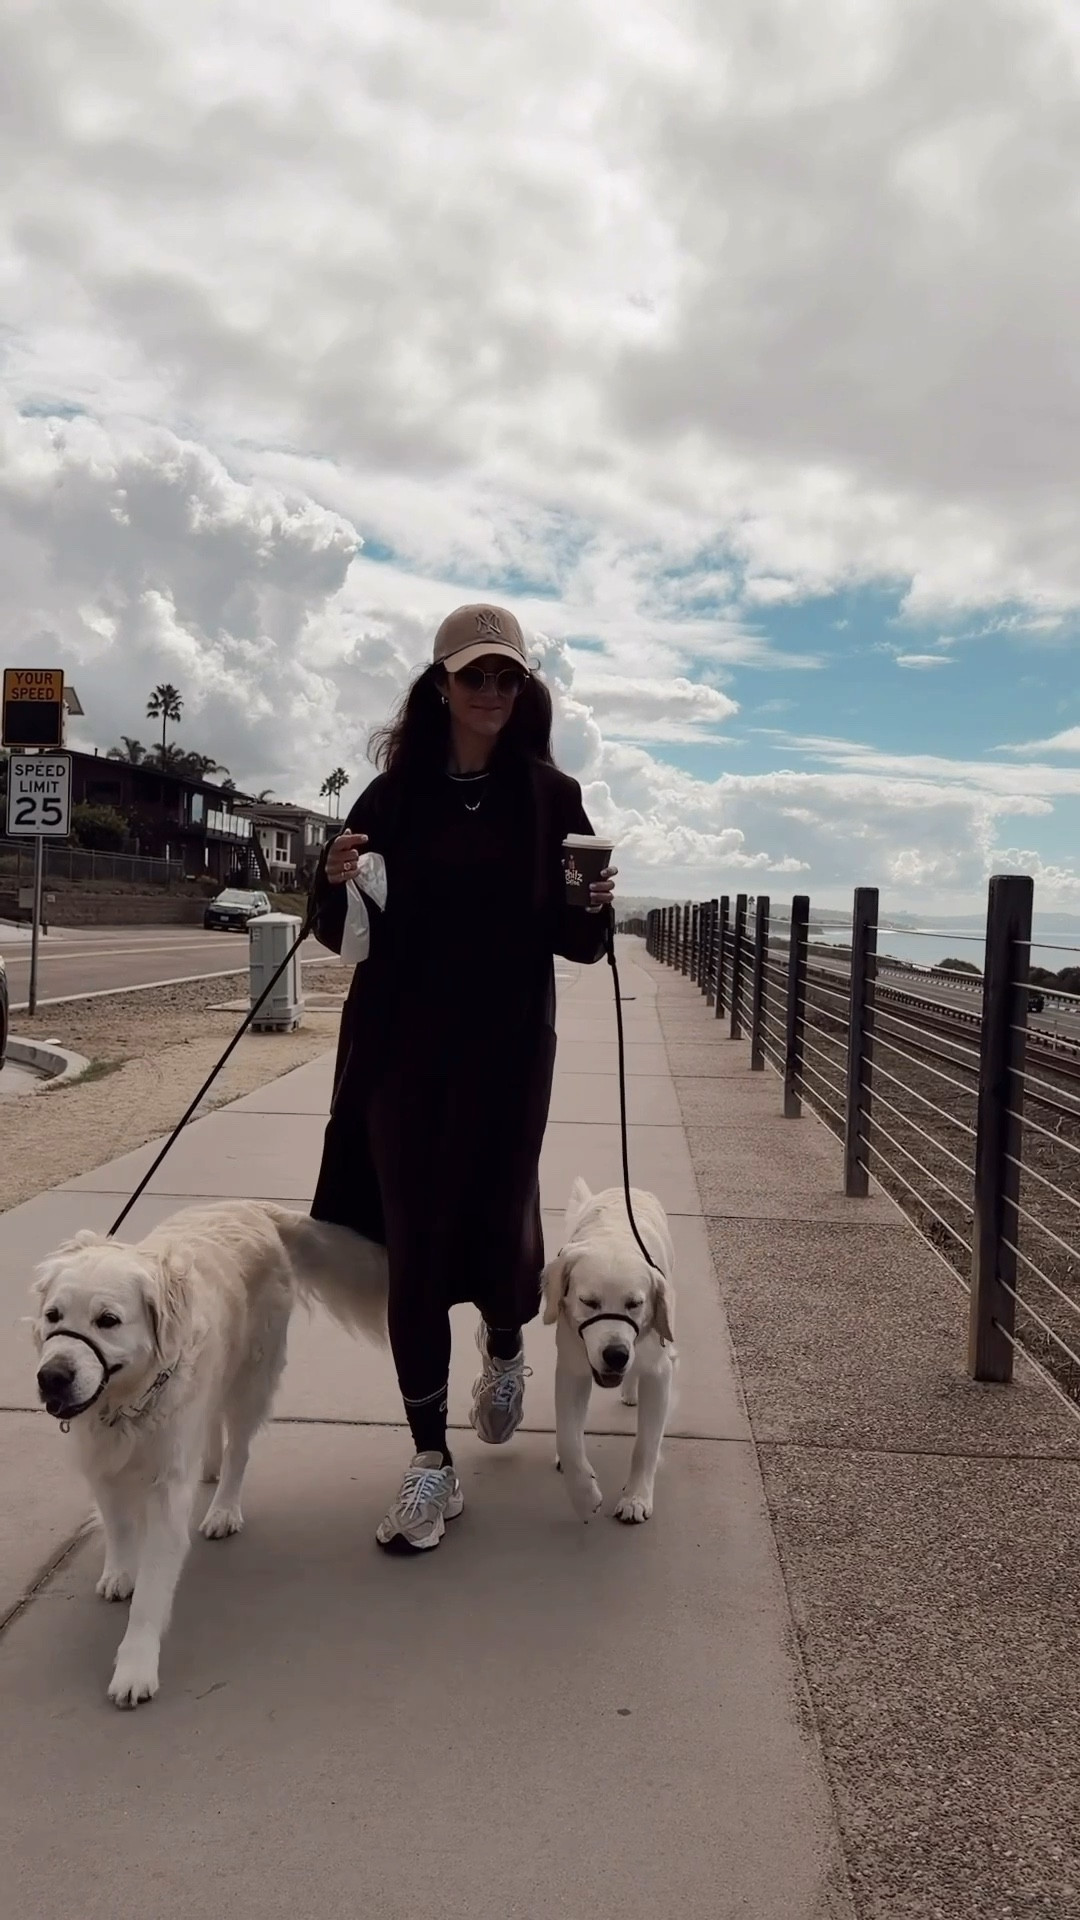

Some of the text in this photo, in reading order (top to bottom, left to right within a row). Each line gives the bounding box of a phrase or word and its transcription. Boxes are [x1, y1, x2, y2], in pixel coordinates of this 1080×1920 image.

[15, 672, 53, 685] YOUR
[11, 687, 54, 700] SPEED
[15, 764, 66, 777] SPEED
[19, 780, 59, 793] LIMIT
[14, 796, 62, 826] 25
